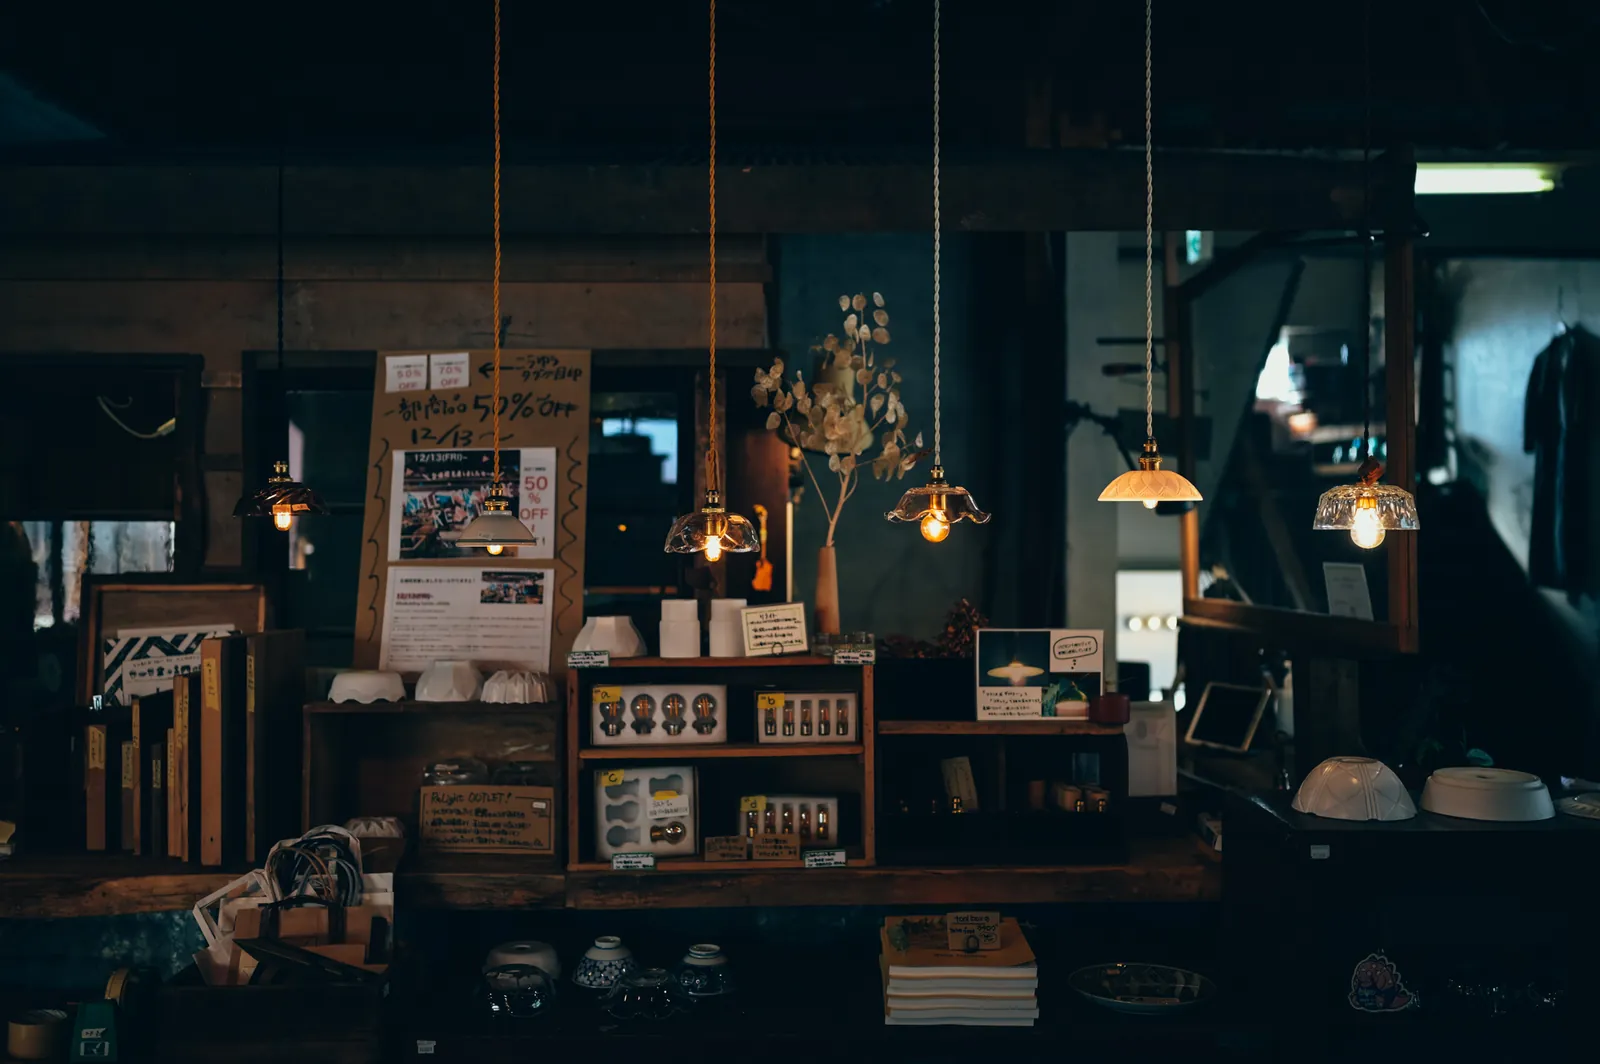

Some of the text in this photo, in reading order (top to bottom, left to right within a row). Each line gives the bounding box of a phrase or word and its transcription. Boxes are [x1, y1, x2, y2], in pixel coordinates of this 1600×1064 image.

[473, 392, 533, 422] 50%
[524, 475, 548, 491] 50
[520, 508, 549, 520] OFF
